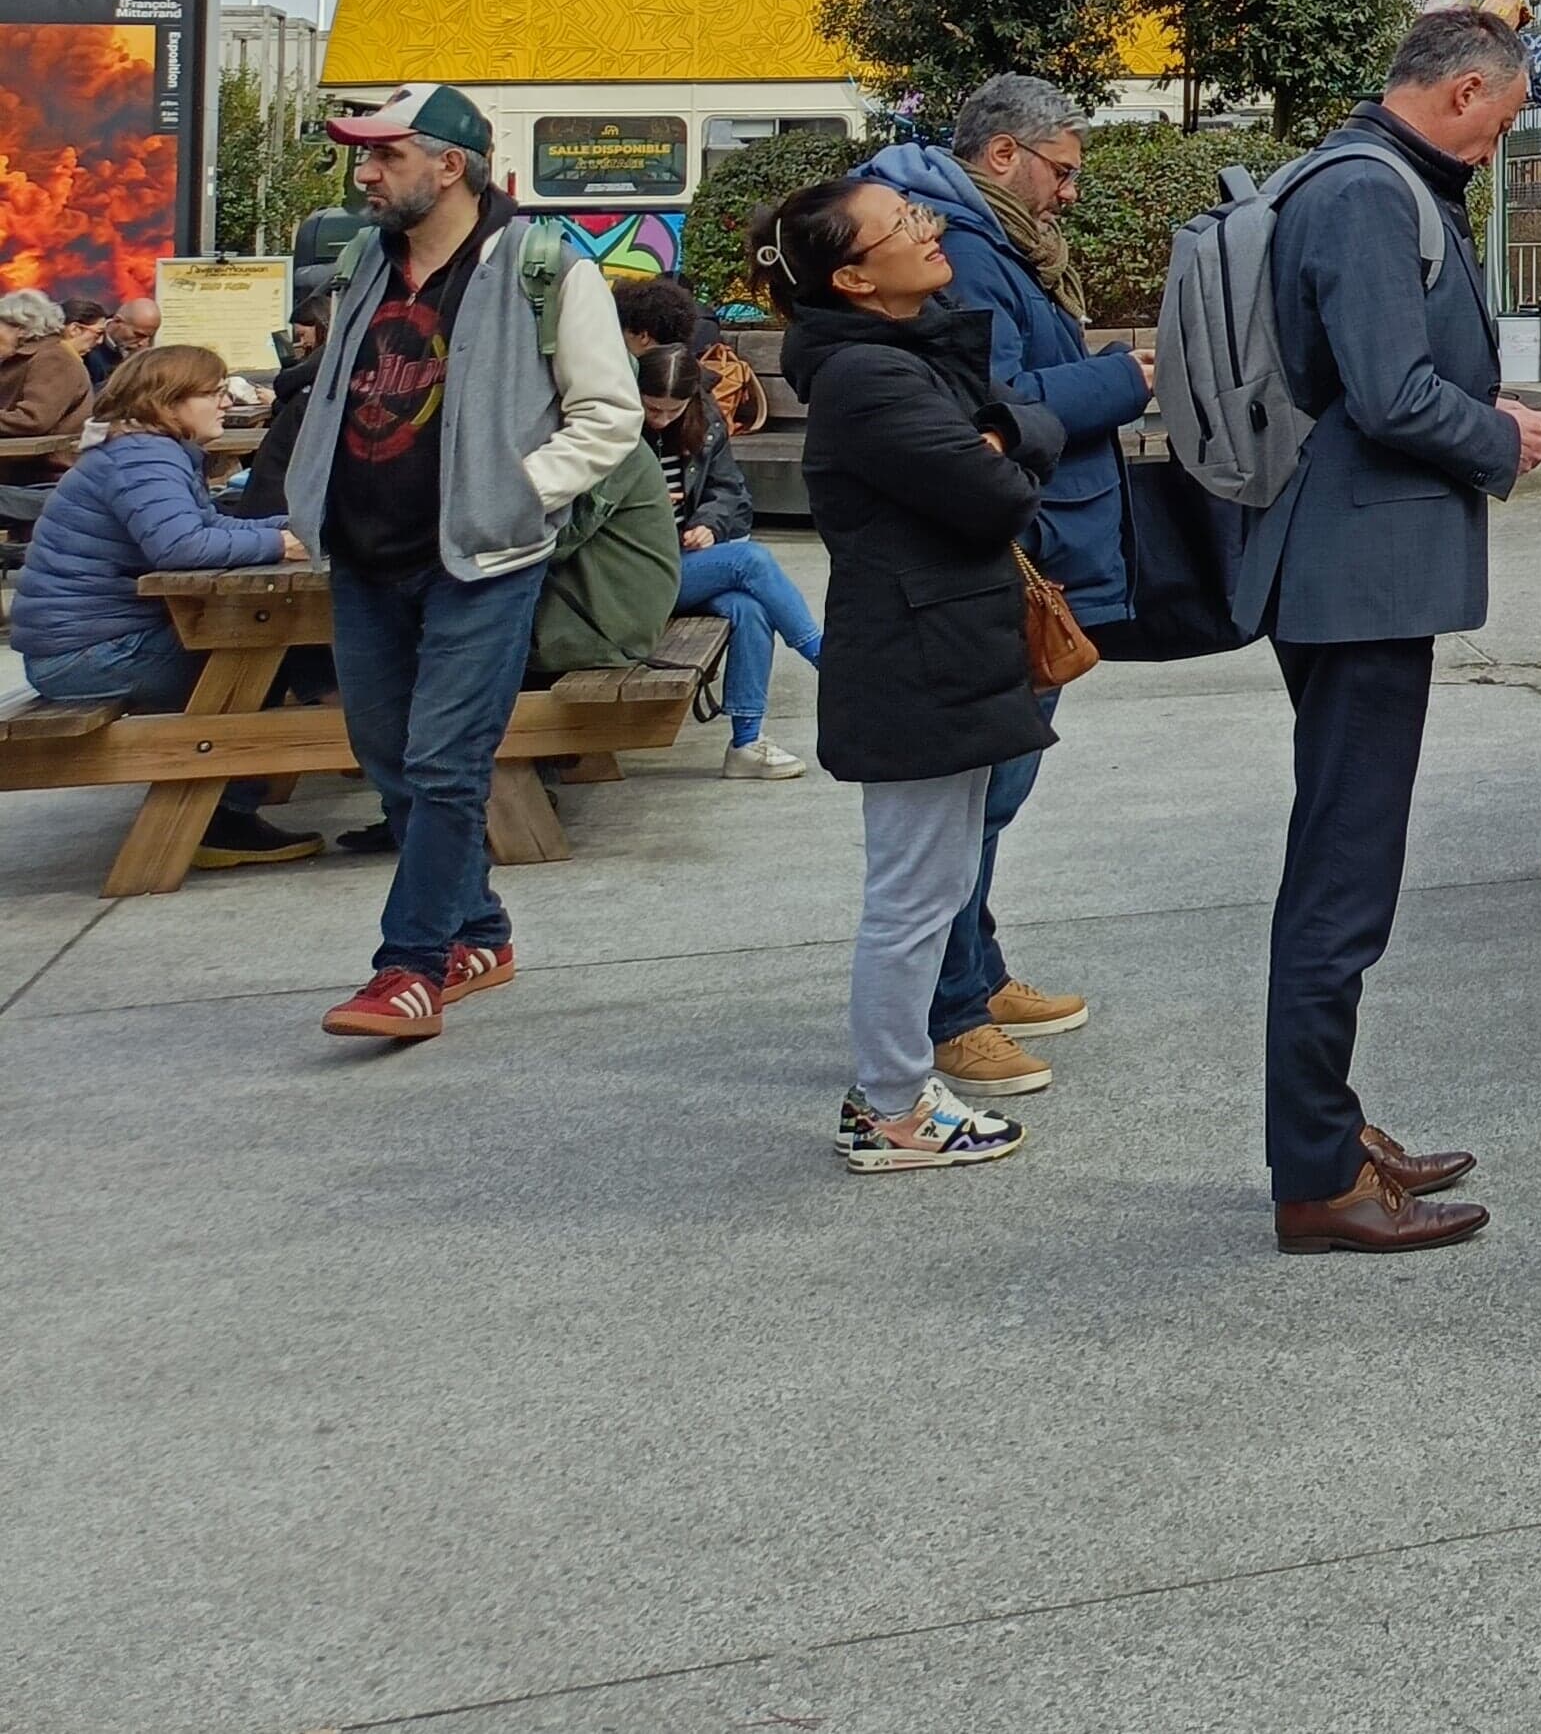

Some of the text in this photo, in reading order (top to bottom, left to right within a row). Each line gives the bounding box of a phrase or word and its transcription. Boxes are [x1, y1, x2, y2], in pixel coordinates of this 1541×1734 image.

[116, 8, 182, 18] Mitterrand
[166, 32, 182, 88] Exposition
[549, 144, 671, 155] SALLE DISPONIBLE
